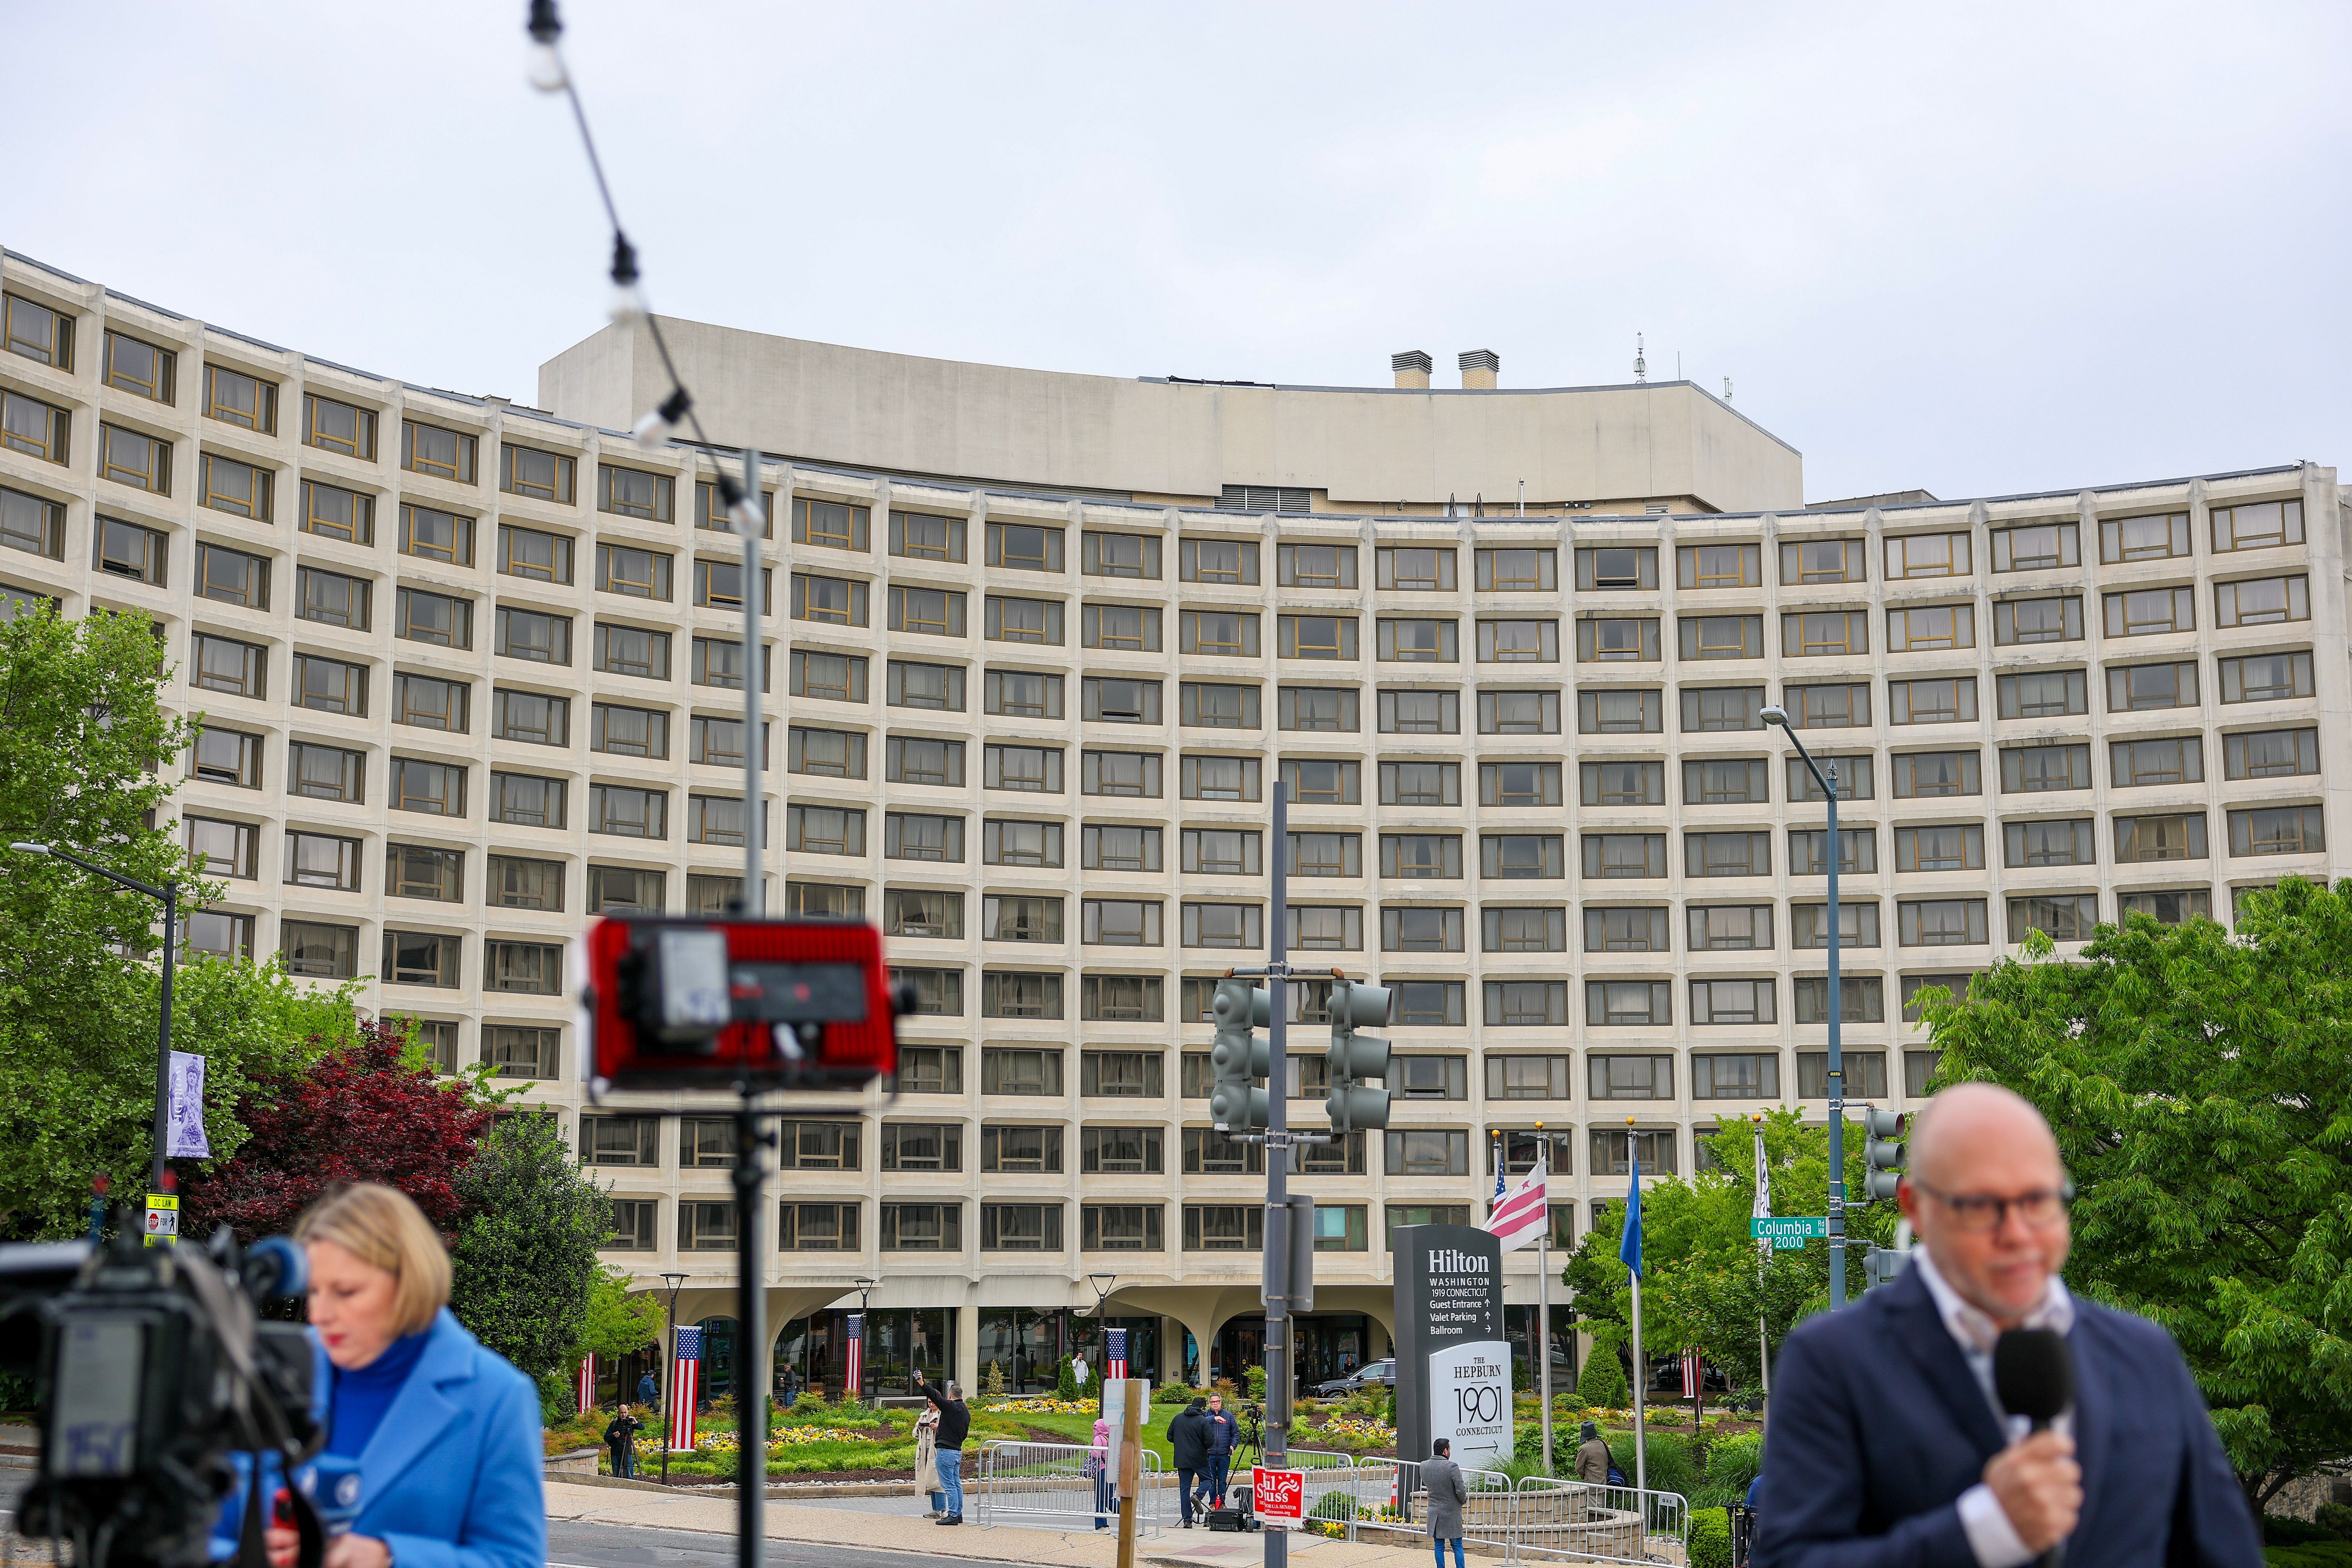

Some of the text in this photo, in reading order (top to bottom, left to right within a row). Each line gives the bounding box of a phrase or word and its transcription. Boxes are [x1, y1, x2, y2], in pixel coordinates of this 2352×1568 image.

[1757, 1220, 1811, 1235] Columbia
[147, 1236, 152, 1245] IN
[1775, 1236, 1803, 1248] 2000
[1428, 1249, 1489, 1273] Hilton
[1429, 1278, 1489, 1286] WASHINGTON
[1432, 1288, 1488, 1297] 1919 CONNECTICUT
[1430, 1300, 1482, 1309] Guest Entrance
[1430, 1312, 1477, 1323] Valet Parking
[1430, 1325, 1463, 1335] Ballroom
[1454, 1365, 1501, 1378] HEPBURN
[1454, 1386, 1502, 1424] 1901
[1456, 1425, 1503, 1436] CONNECTICUT
